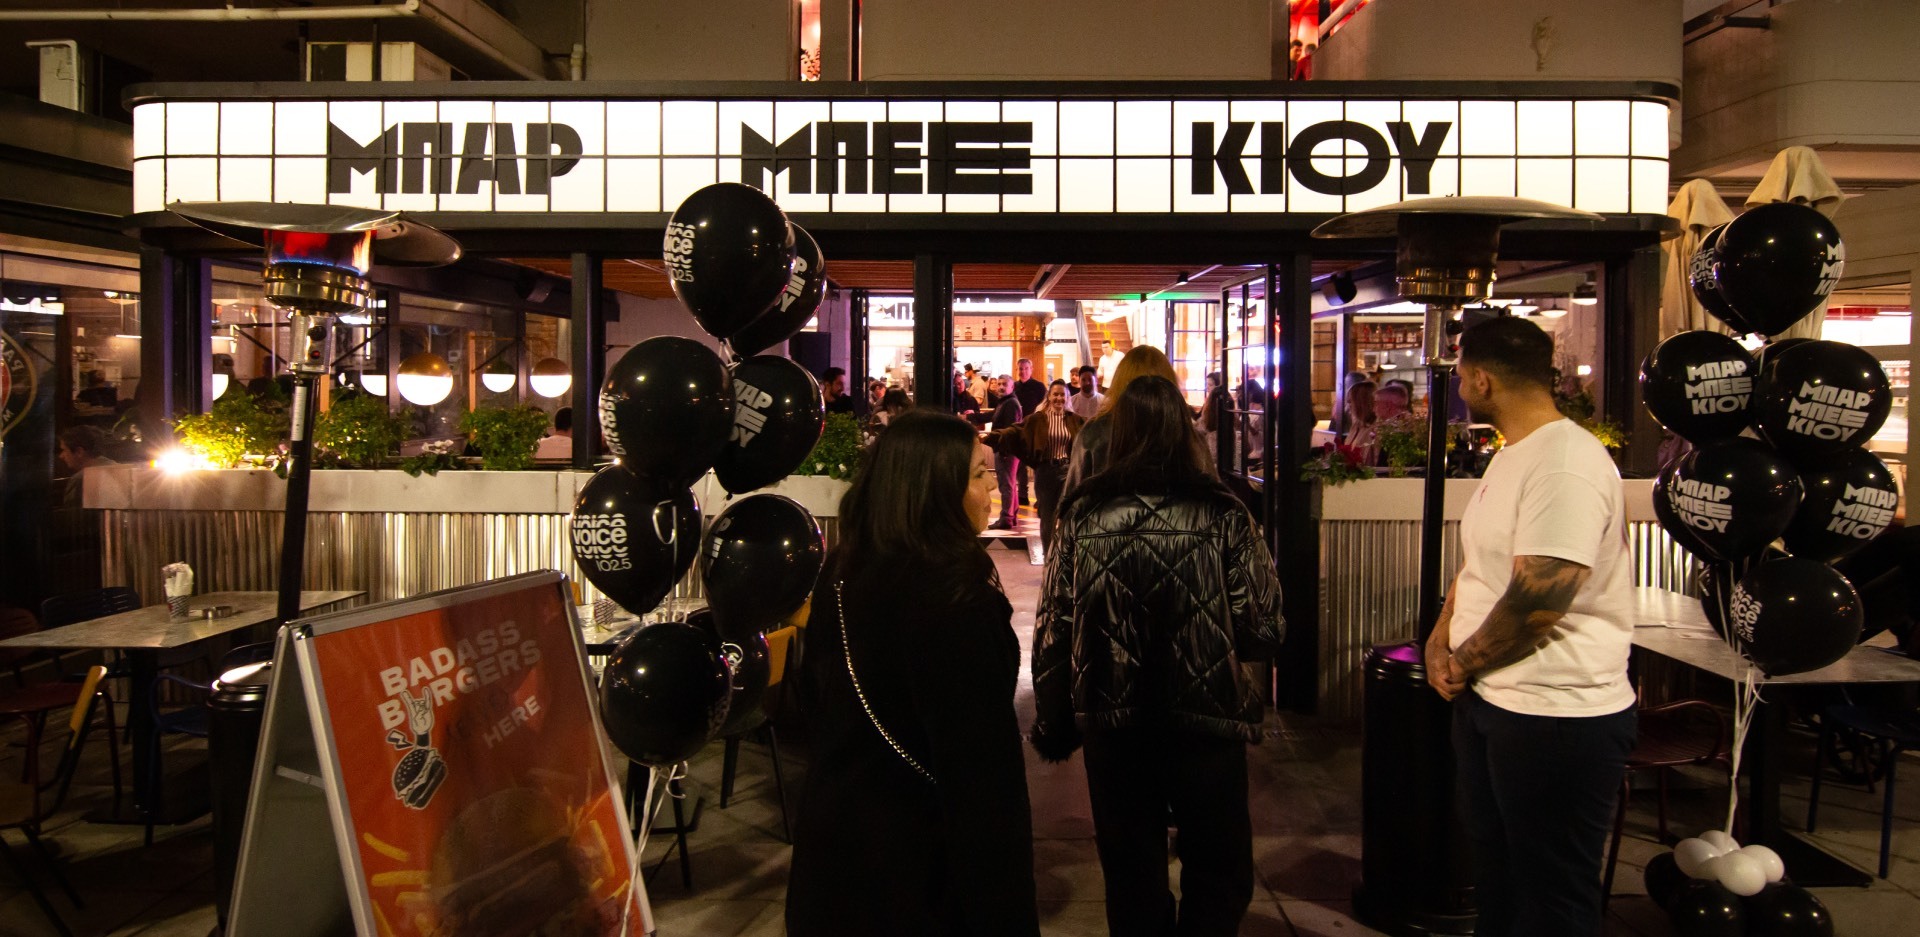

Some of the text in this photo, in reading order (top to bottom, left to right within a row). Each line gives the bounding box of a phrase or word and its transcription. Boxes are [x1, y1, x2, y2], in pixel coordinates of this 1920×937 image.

[328, 120, 1453, 196] ΜΠΑΡ ΜΠΕΕ ΚΙΟΥ
[1686, 360, 1747, 382] ΜΠΑΡ
[1684, 376, 1753, 399] ΜΠΕΕ
[1799, 381, 1872, 410] ΜΠΑΡ
[1692, 395, 1751, 415] ΚΙΟΥ
[1787, 396, 1869, 429] ΜΠΕΕ
[1786, 416, 1860, 443] ΚΙΟΥ
[1677, 475, 1732, 502] ΜΠΑΡ
[1843, 482, 1897, 510] ΜΠΑΡ
[1674, 491, 1733, 521] ΜΠΕΕ
[1831, 499, 1895, 528] ΜΠΕΕ
[379, 620, 520, 697] BADASS
[482, 695, 542, 750] HERE
